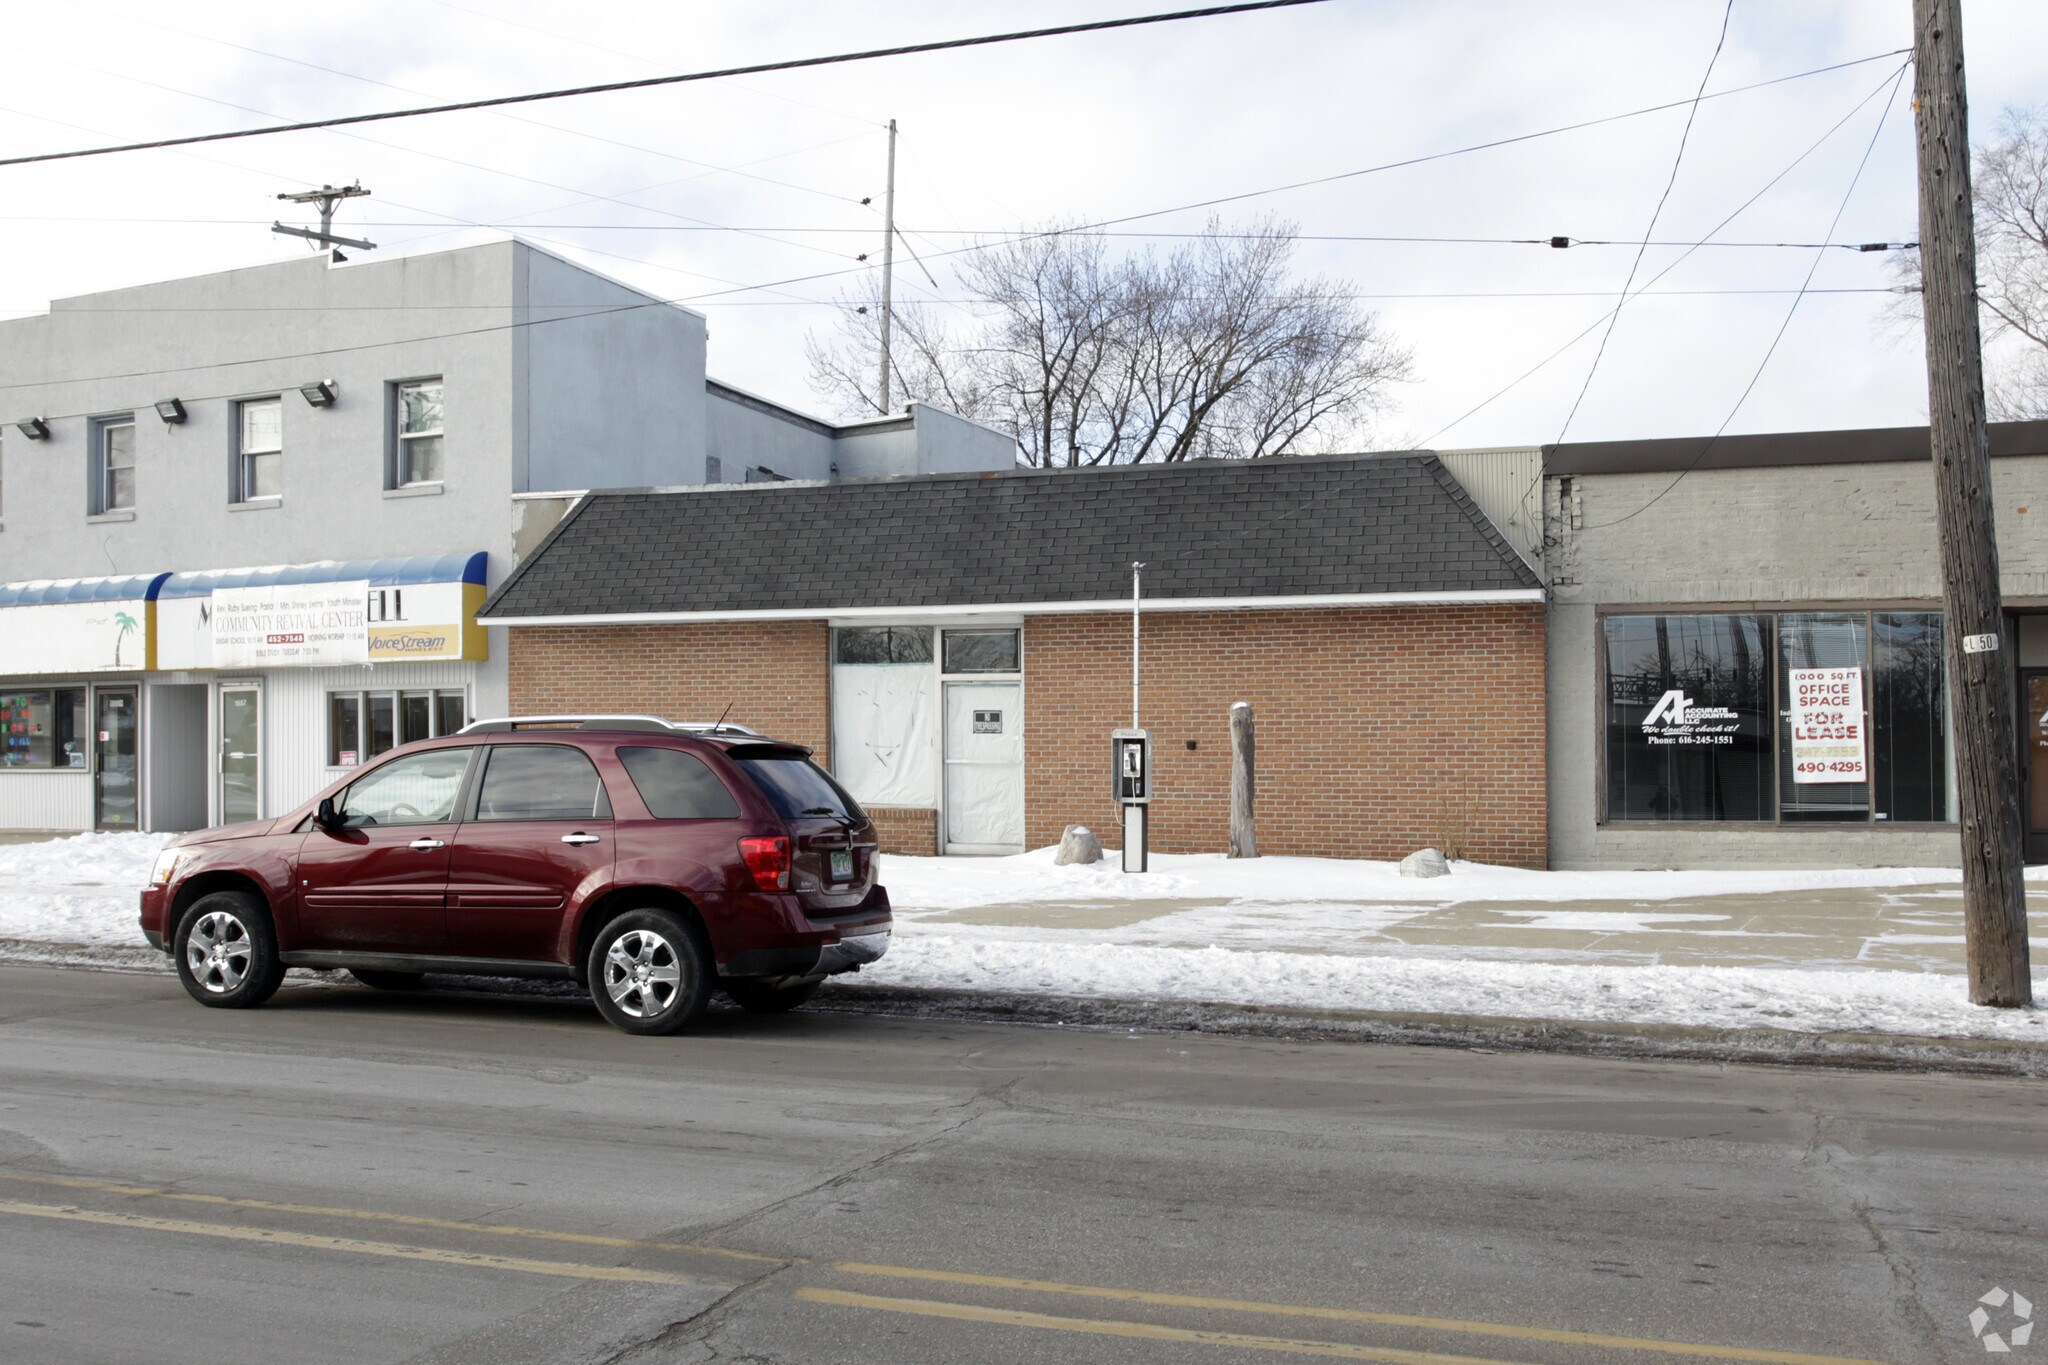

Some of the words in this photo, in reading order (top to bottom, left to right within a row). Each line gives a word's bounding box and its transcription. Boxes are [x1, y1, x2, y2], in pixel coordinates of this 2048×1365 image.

[228, 603, 239, 613] Ruby
[367, 589, 408, 622] ELL
[216, 614, 274, 633] COMMUNITY
[277, 612, 319, 631] REVIVAL
[322, 610, 363, 629] CENTER
[230, 637, 245, 645] SCHOOL
[368, 635, 445, 652] VoiceStream
[1980, 635, 1993, 650] 50
[1799, 684, 1849, 695] OFFICE
[1799, 696, 1850, 707] SPACE
[1804, 711, 1844, 725] FOR
[1641, 725, 1660, 734] We
[1661, 724, 1694, 733] double
[1695, 724, 1723, 733] check
[1724, 723, 1740, 732] it!
[1795, 726, 1858, 740] LEASE
[1648, 736, 1676, 744] Phone:
[1678, 735, 1733, 744] 616-245-1551
